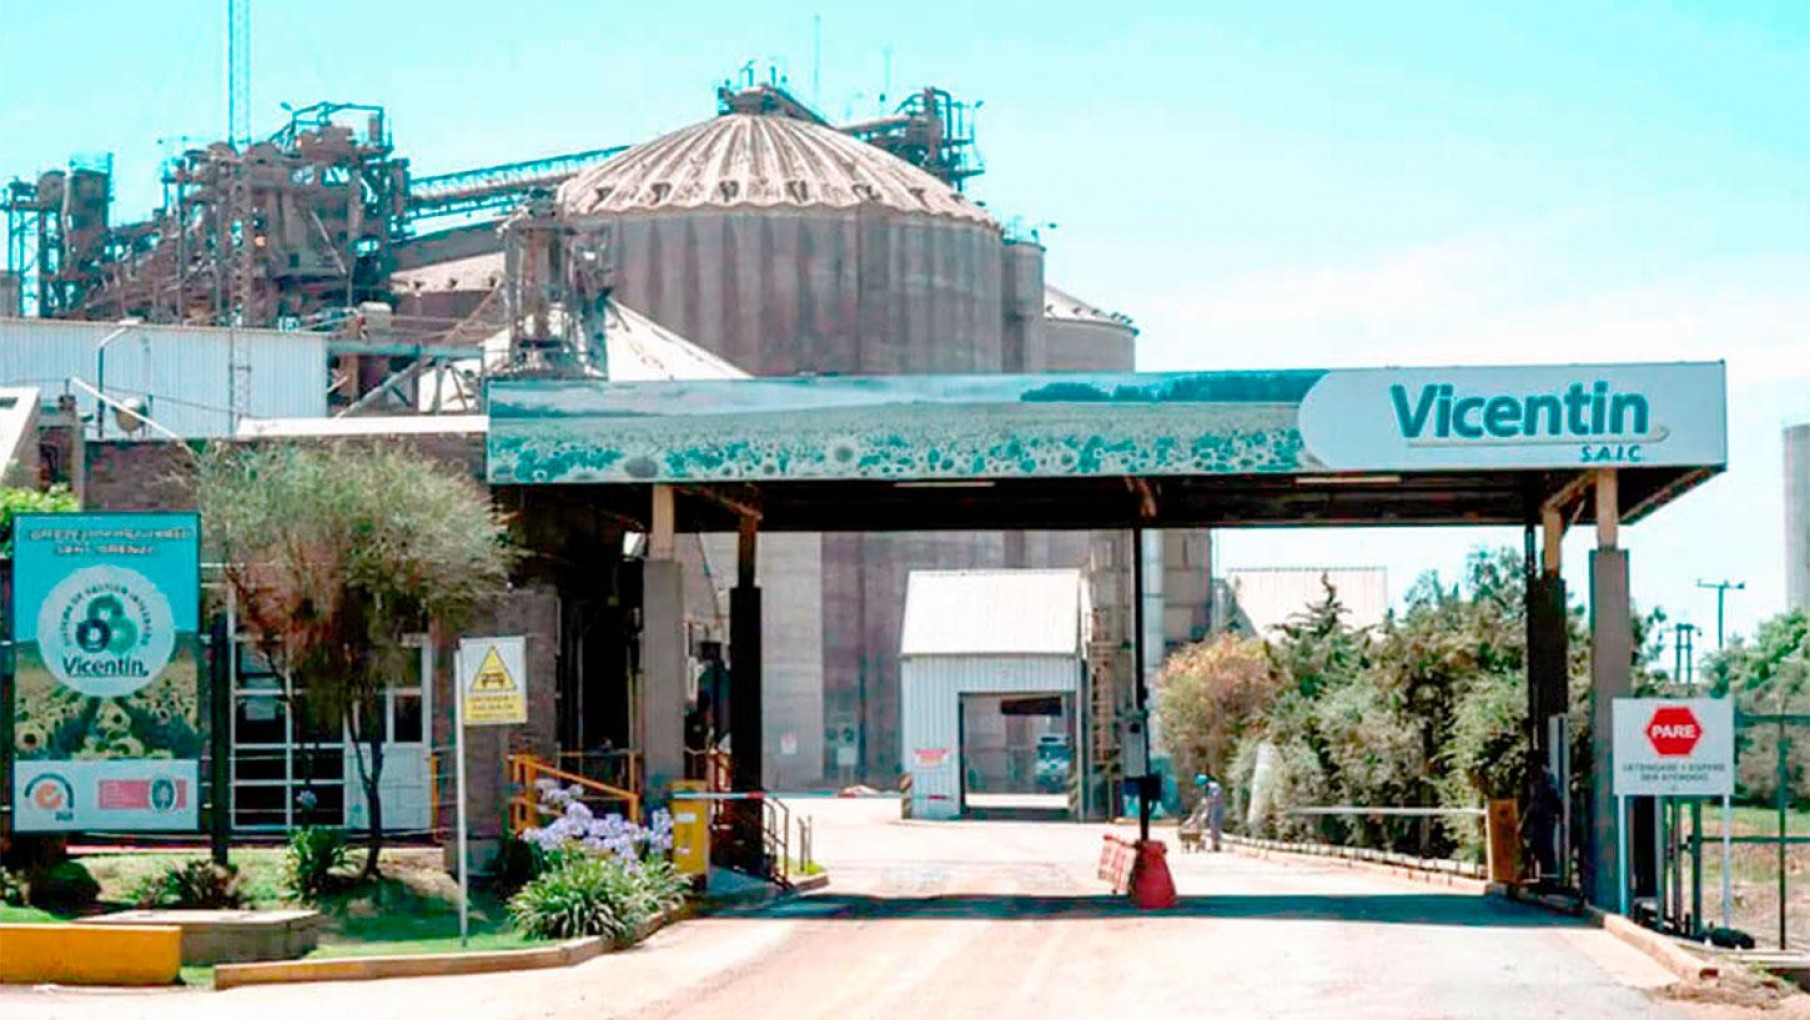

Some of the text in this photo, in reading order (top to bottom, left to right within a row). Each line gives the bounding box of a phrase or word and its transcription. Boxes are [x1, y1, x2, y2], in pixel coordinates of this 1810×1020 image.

[1390, 380, 1650, 438] Vicentin
[1581, 445, 1642, 463] SAIC
[62, 654, 144, 676] Vicentin
[1651, 724, 1697, 739] PARE
